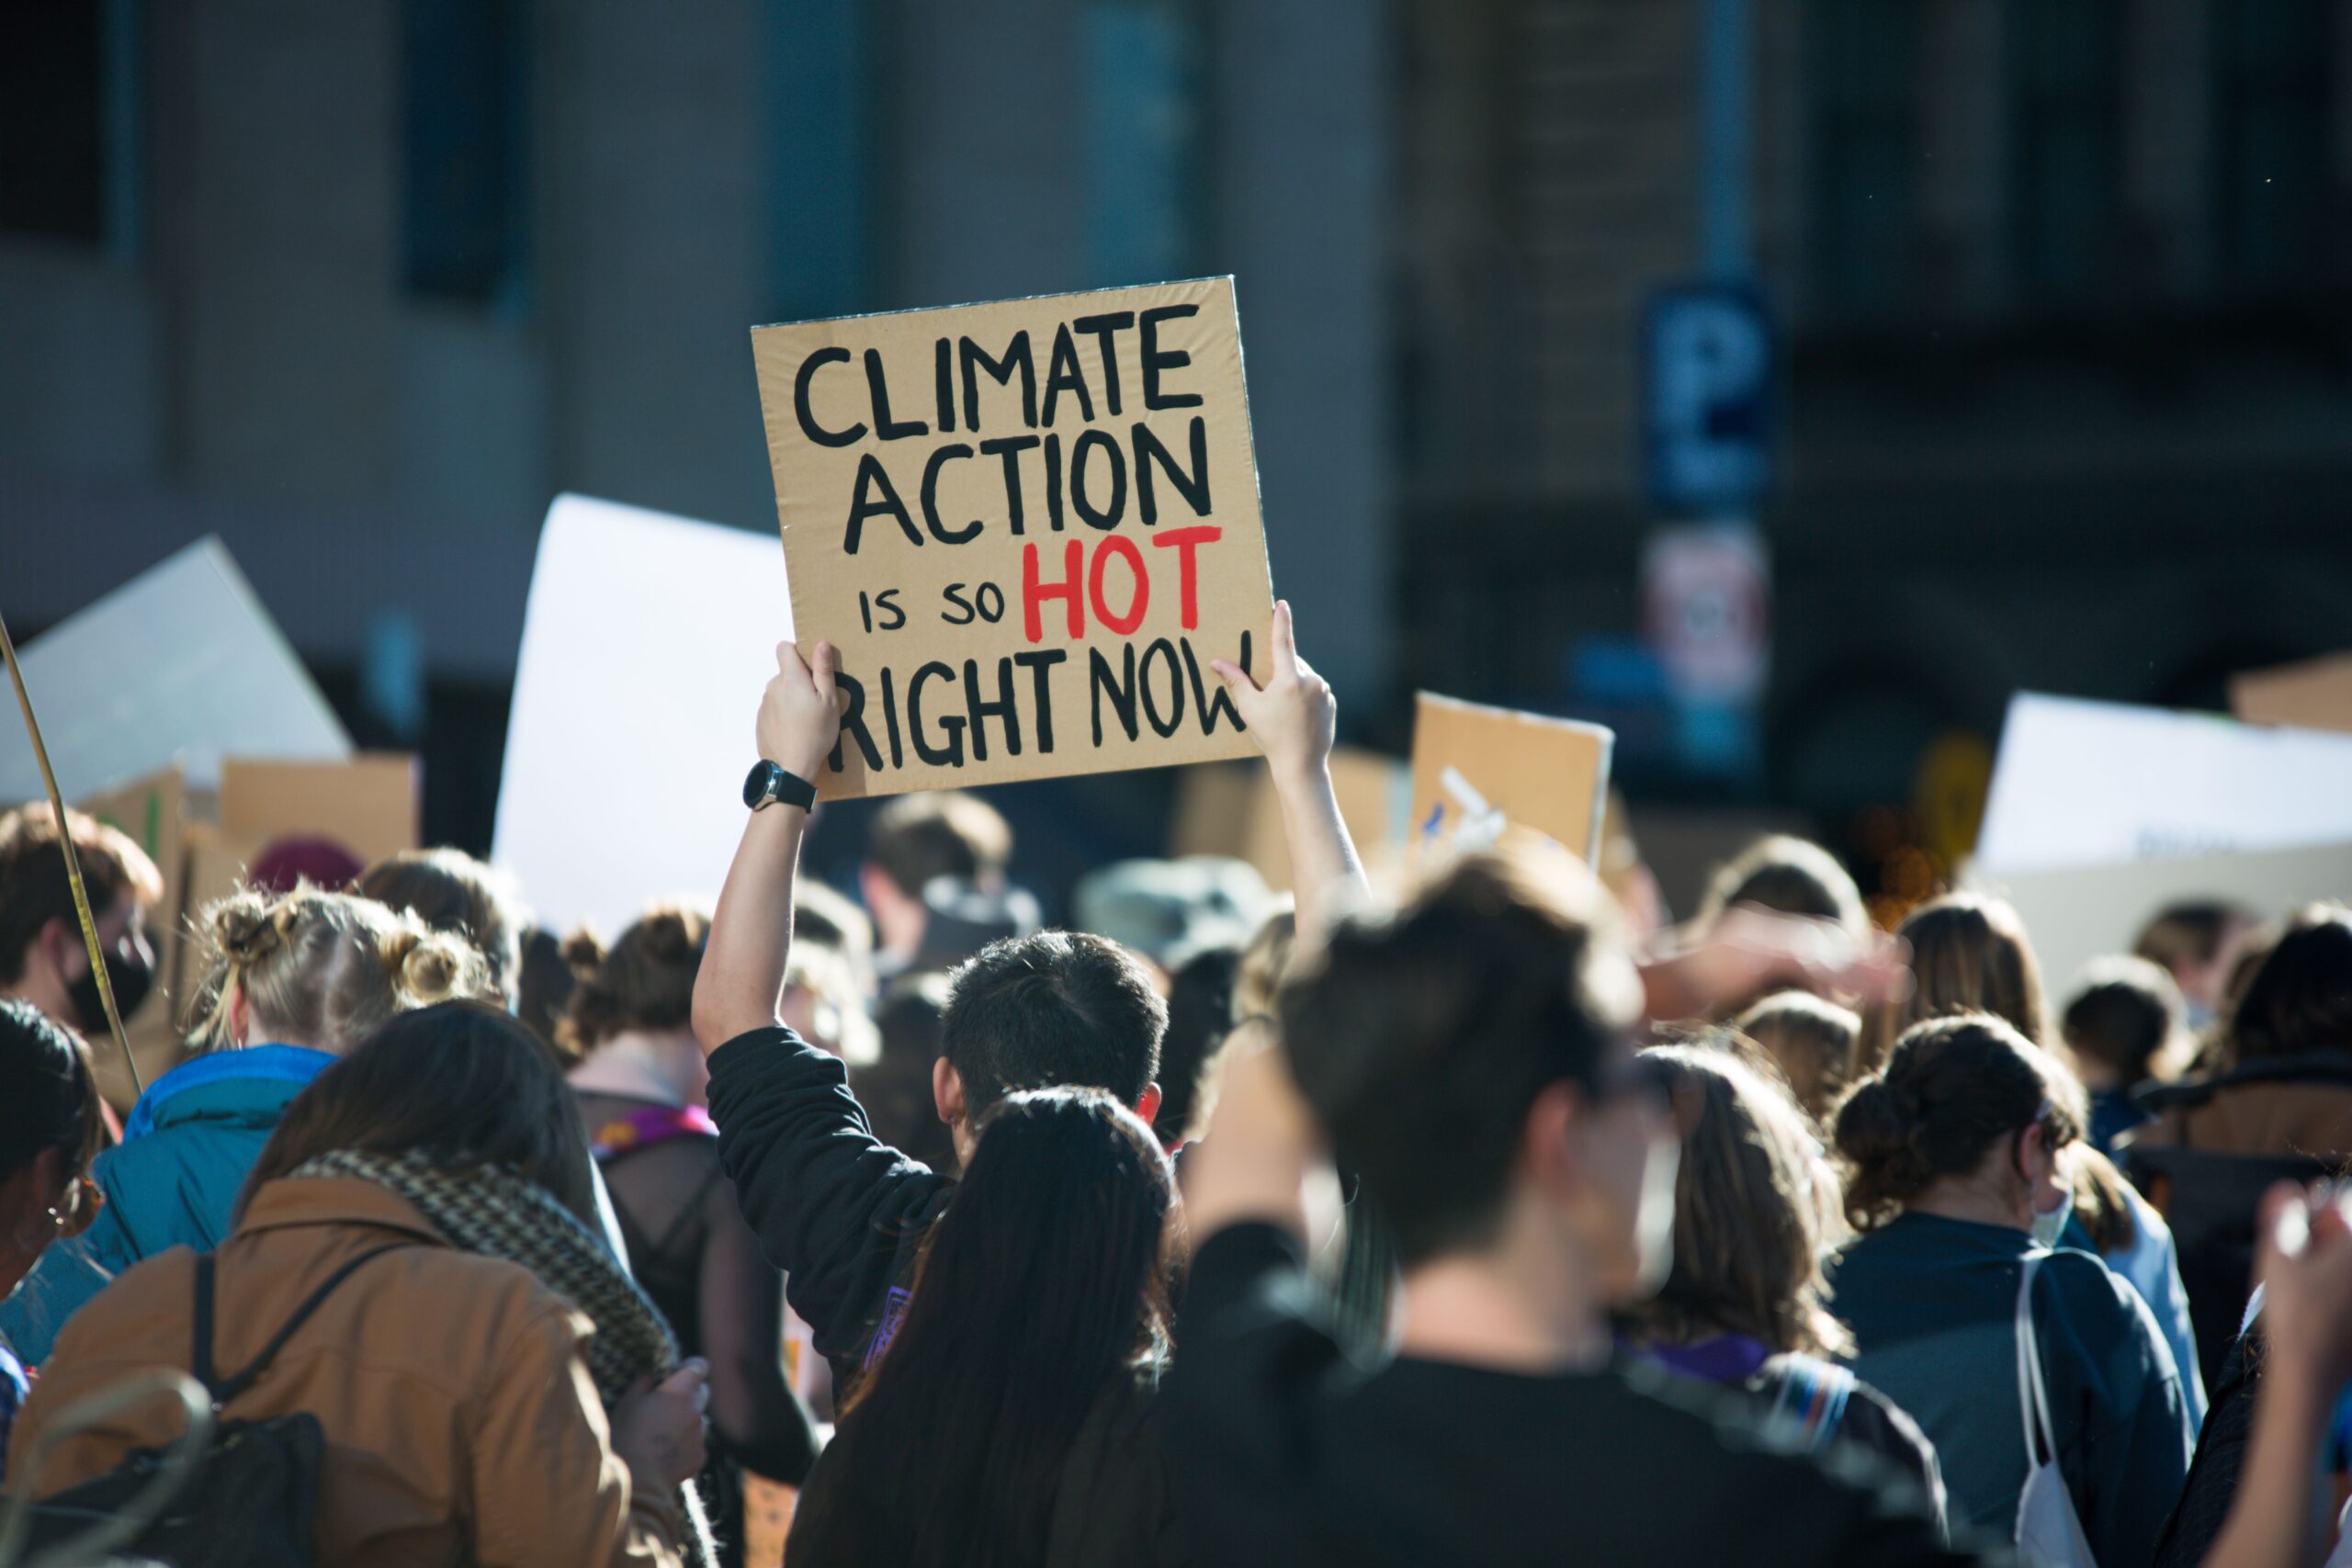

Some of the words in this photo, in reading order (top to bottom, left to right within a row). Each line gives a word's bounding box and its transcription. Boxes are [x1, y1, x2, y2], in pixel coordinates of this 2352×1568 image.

[793, 303, 1204, 448] CLIMATE
[843, 415, 1213, 556] ACTION
[859, 588, 907, 634] IS
[940, 581, 1005, 625] SO
[1022, 525, 1223, 643] HOT
[828, 649, 1068, 773] RIGHT
[1089, 629, 1252, 748] NOW
